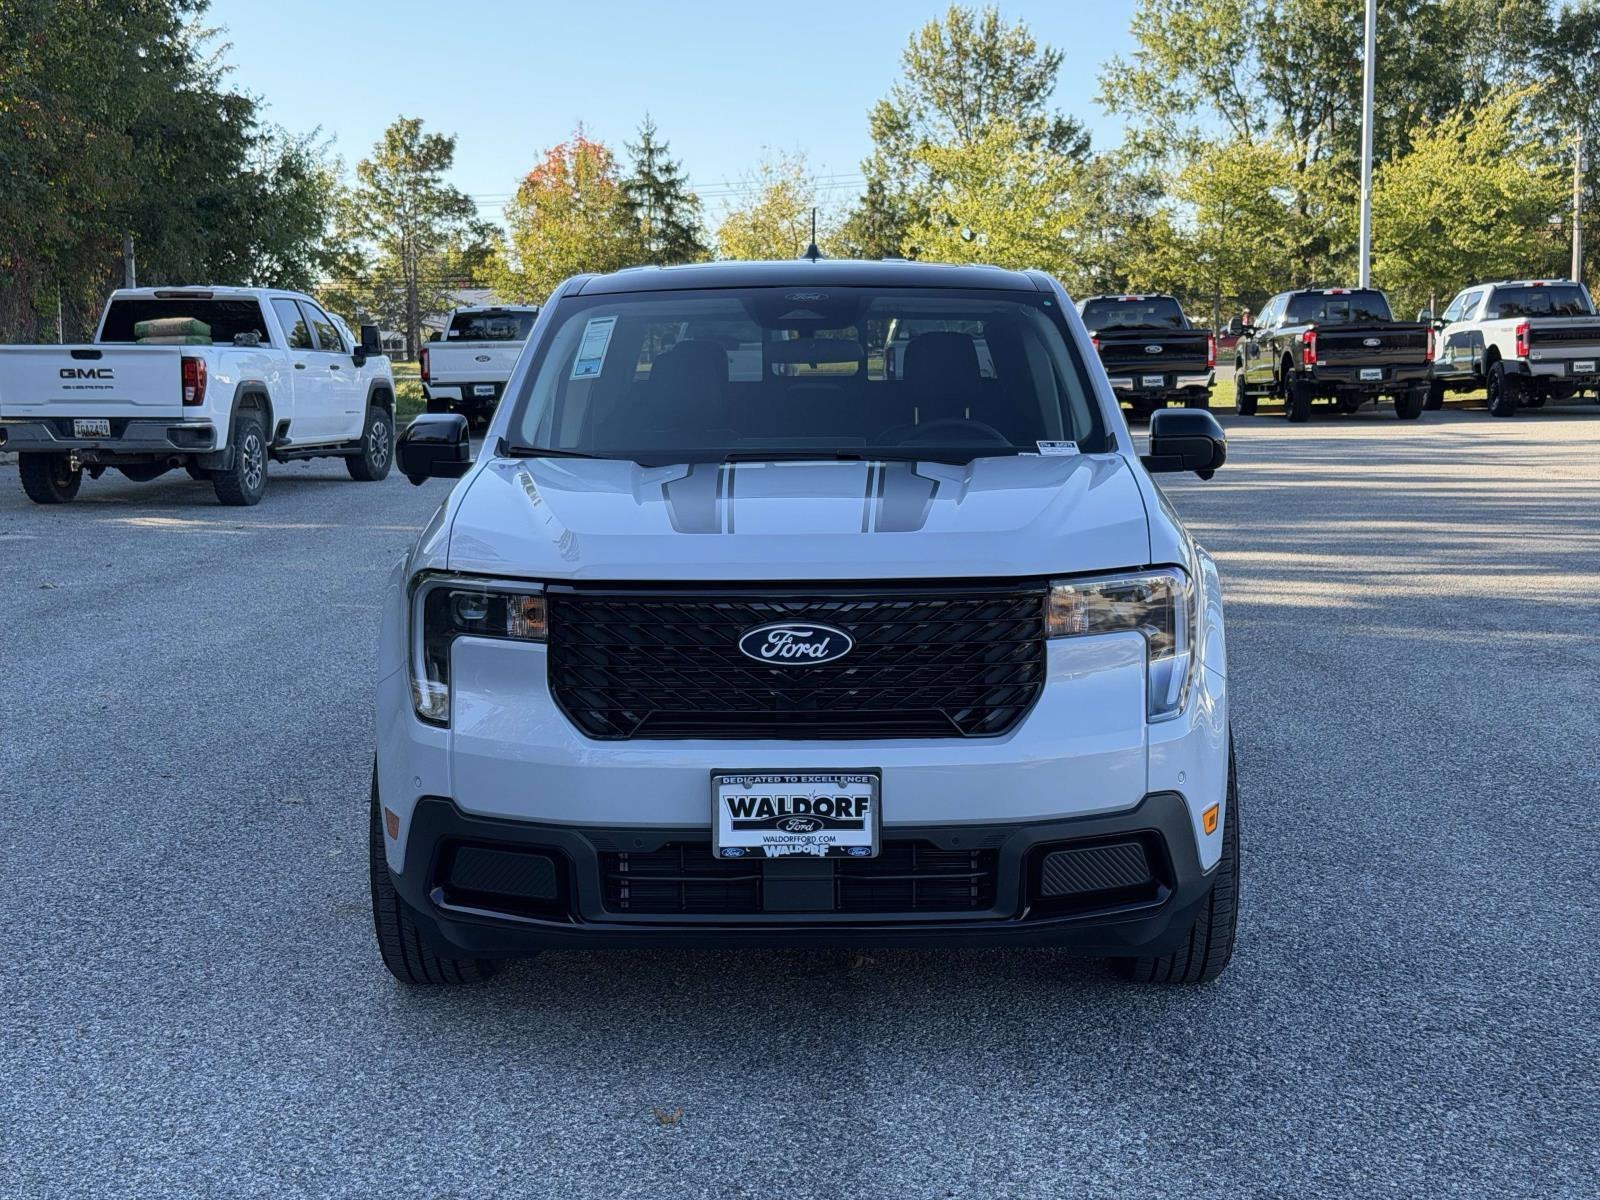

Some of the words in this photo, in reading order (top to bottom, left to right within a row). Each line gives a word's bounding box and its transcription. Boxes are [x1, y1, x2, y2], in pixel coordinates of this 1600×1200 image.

[60, 368, 114, 379] GMC
[761, 630, 830, 657] Ford
[723, 776, 780, 784] DEDICATED
[801, 775, 869, 783] EXCELLENCE
[726, 797, 870, 818] WALDORF
[785, 819, 814, 832] Ford
[763, 835, 836, 843] WALDORFFORD.COM
[724, 848, 742, 856] Ford
[762, 844, 829, 857] WALDORF
[850, 847, 867, 856] Ford
